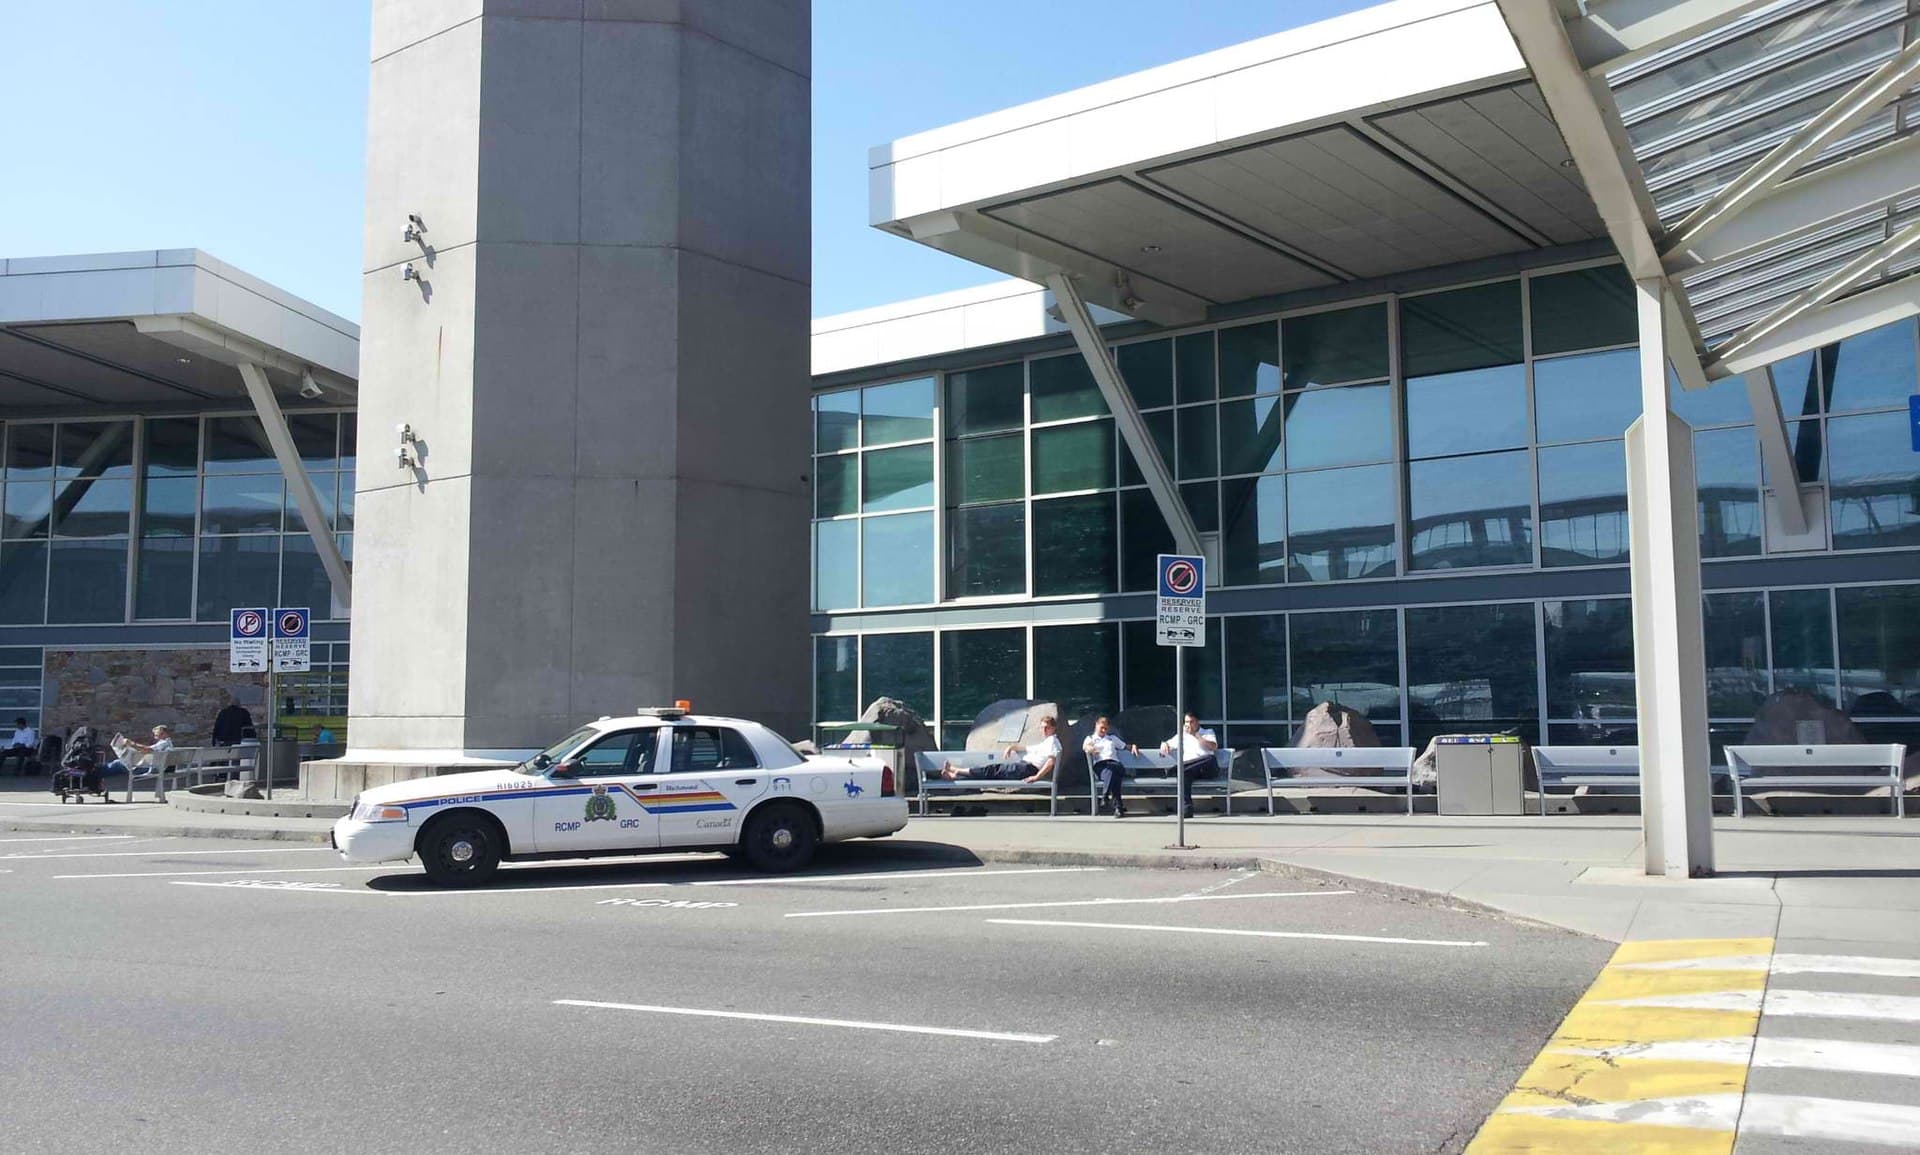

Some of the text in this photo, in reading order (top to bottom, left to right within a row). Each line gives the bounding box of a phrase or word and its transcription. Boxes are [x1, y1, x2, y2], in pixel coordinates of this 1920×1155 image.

[1161, 599, 1202, 607] RESERVED
[1159, 615, 1181, 625] RCMP
[1187, 615, 1204, 625] GRC
[440, 795, 482, 806] POLICE
[554, 819, 640, 832] RCMP GRC
